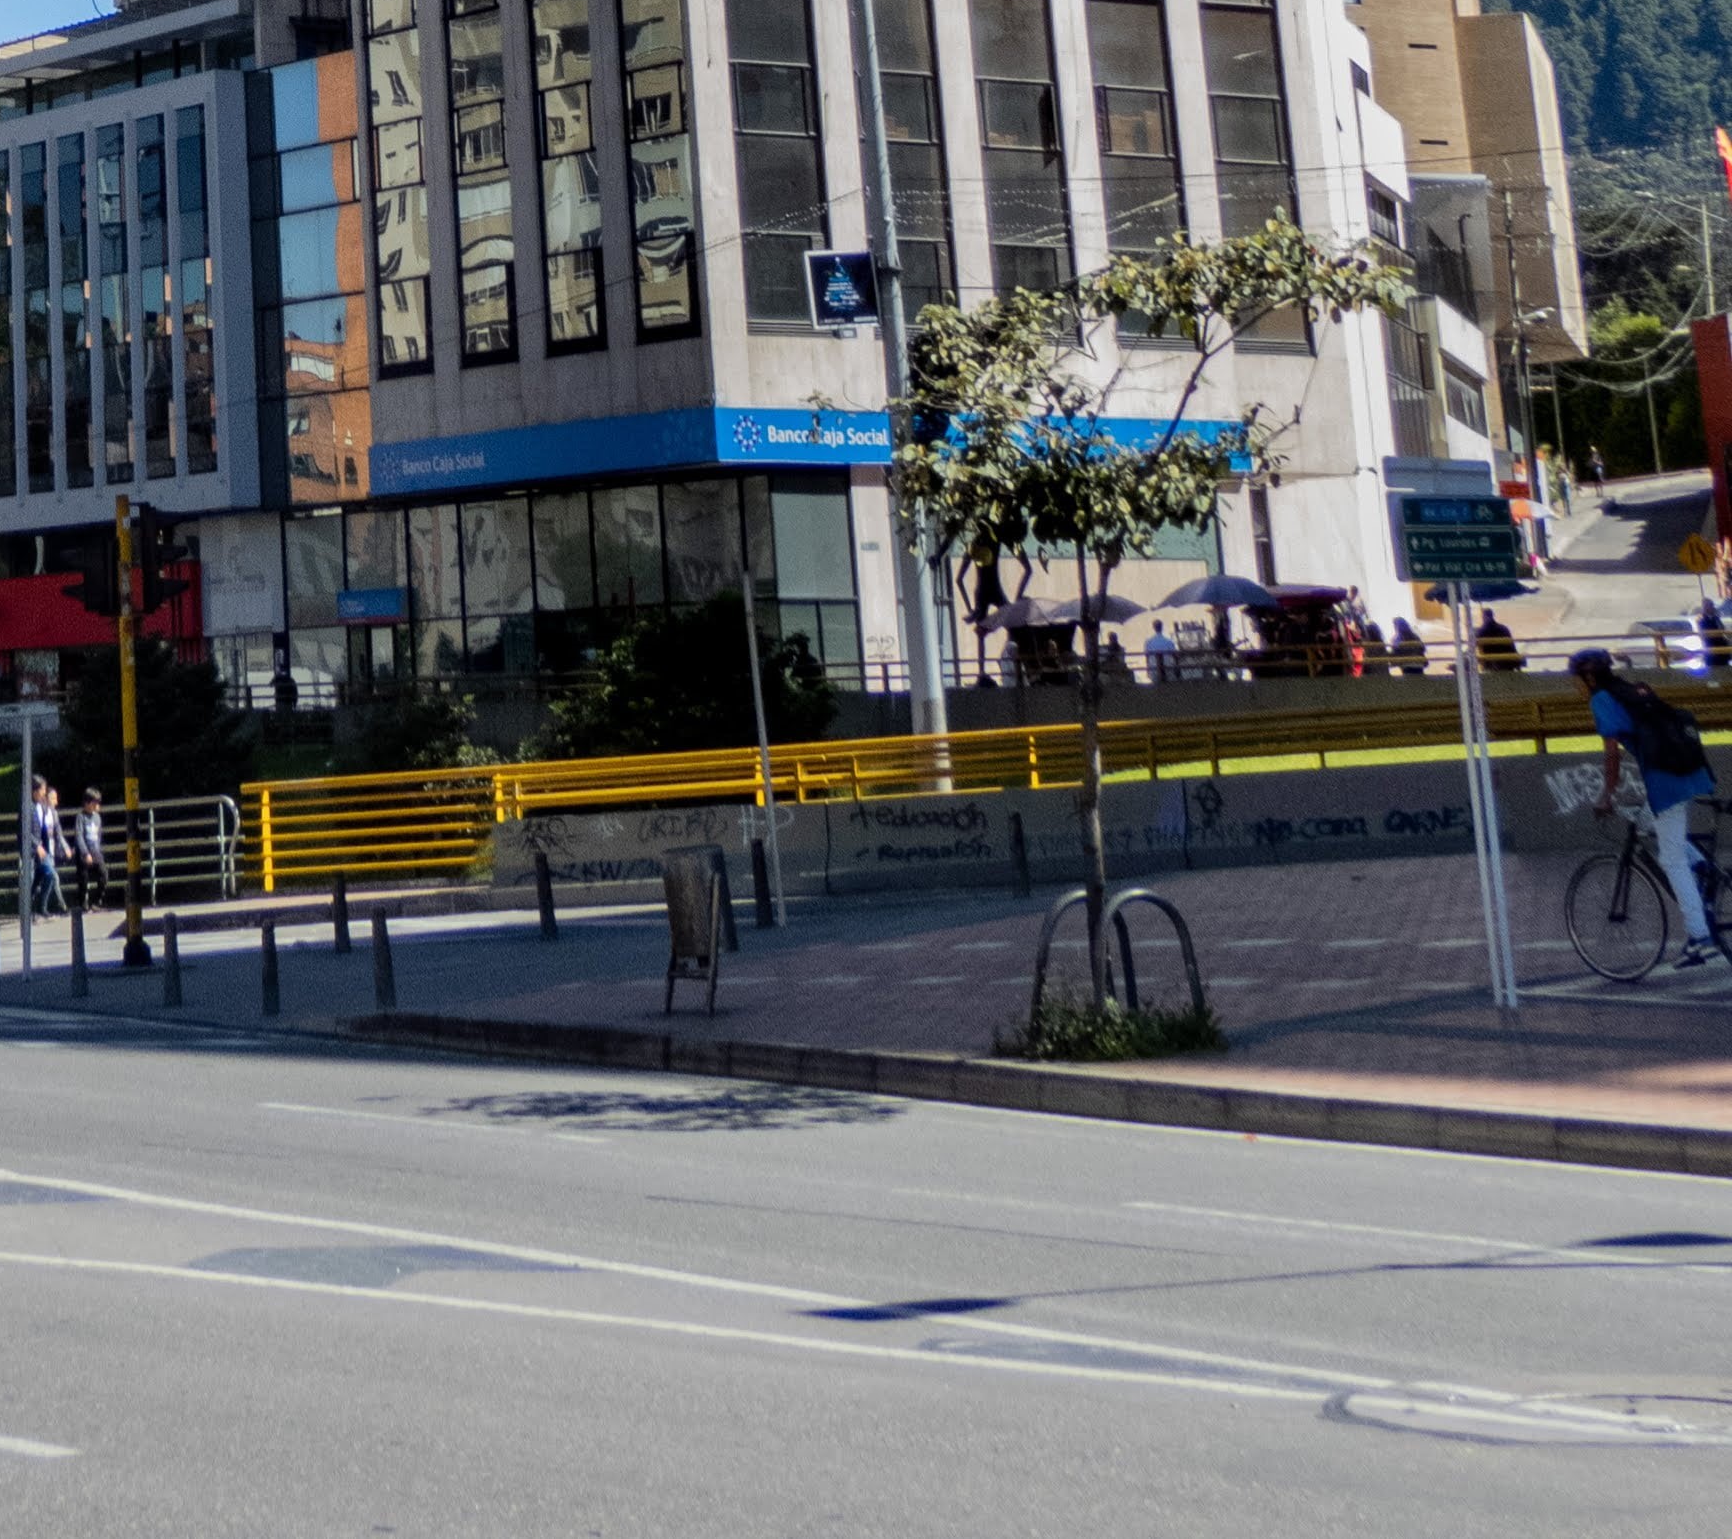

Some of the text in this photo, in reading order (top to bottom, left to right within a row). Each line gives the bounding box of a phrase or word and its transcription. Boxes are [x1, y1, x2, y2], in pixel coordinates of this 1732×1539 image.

[847, 427, 890, 446] Social
[402, 450, 485, 476] Banco Caja Social
